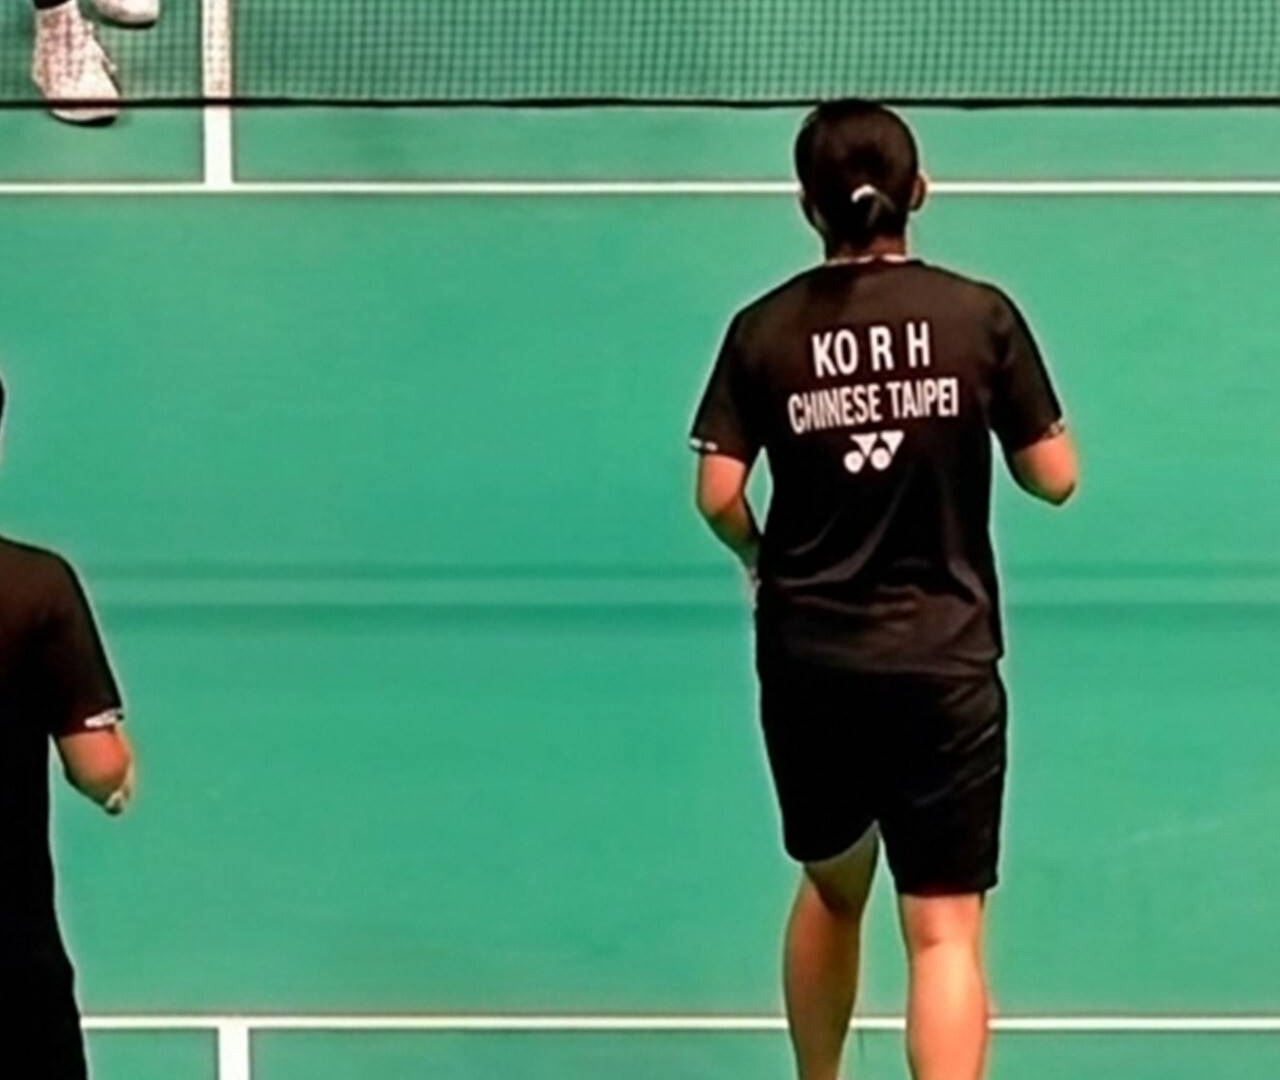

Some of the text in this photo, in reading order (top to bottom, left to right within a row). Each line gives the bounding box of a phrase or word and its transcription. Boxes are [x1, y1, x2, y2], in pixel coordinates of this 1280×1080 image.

[811, 320, 931, 378] KO R H
[787, 377, 959, 435] CHINESE TAIPEI
